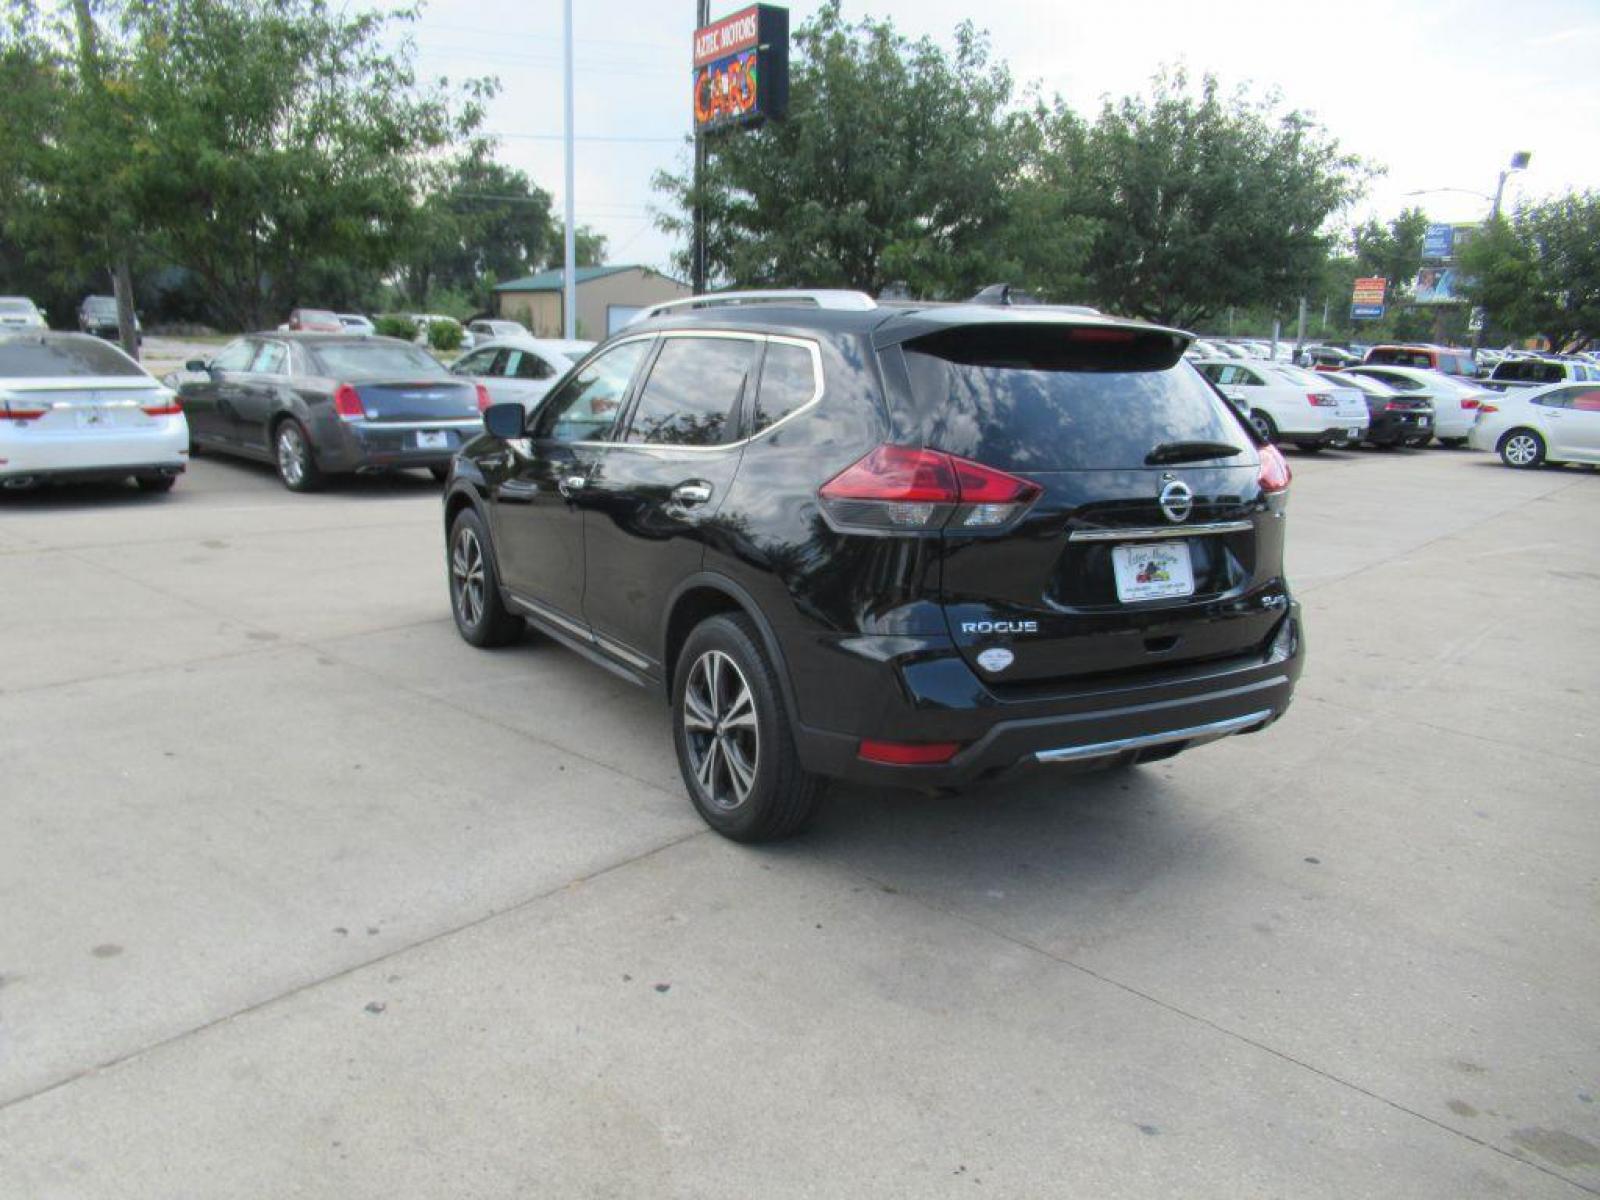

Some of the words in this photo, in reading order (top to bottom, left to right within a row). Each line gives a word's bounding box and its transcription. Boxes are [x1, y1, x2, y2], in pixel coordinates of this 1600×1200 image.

[696, 31, 719, 59] AZTEC
[721, 14, 757, 47] MOTORS
[695, 55, 757, 124] CARS
[961, 621, 1038, 634] ROGUE
